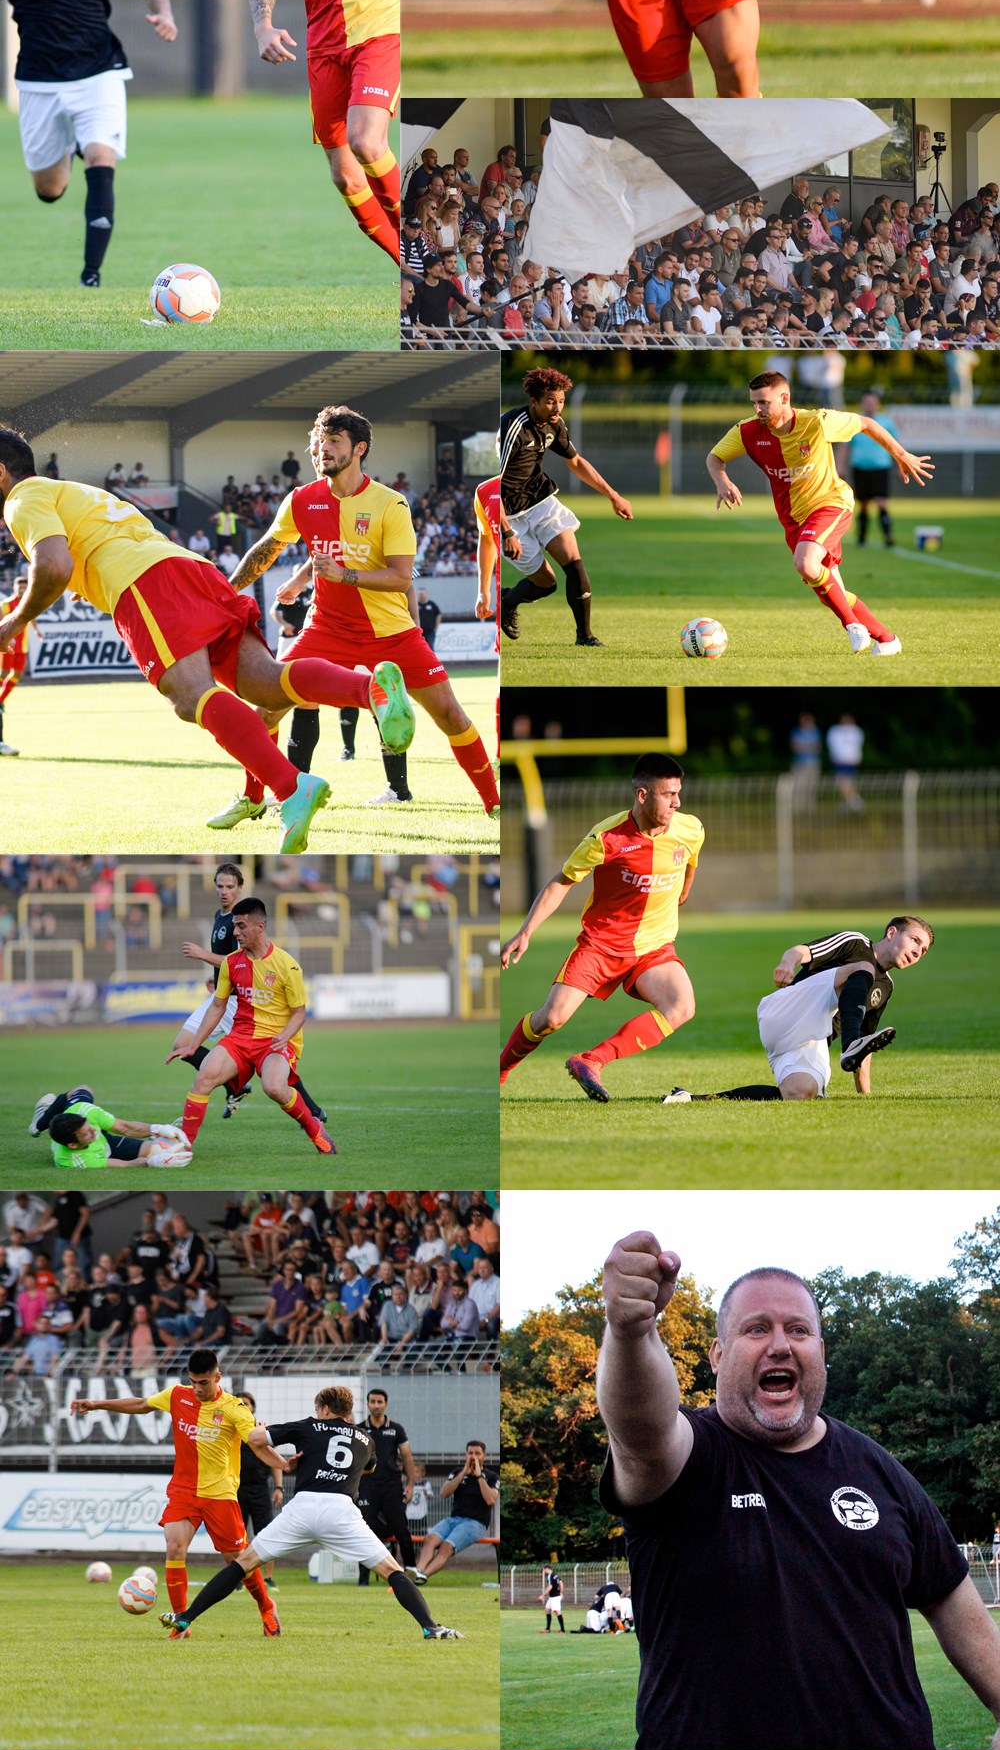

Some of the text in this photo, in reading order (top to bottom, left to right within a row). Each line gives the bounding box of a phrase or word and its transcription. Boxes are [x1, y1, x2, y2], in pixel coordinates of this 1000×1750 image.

[362, 86, 390, 98] Joma
[765, 464, 814, 479] tipico
[621, 868, 680, 888] tipico
[178, 1420, 220, 1437] tipico
[354, 1430, 370, 1446] 1893
[326, 1435, 353, 1469] 6
[21, 1497, 168, 1533] easycoupo
